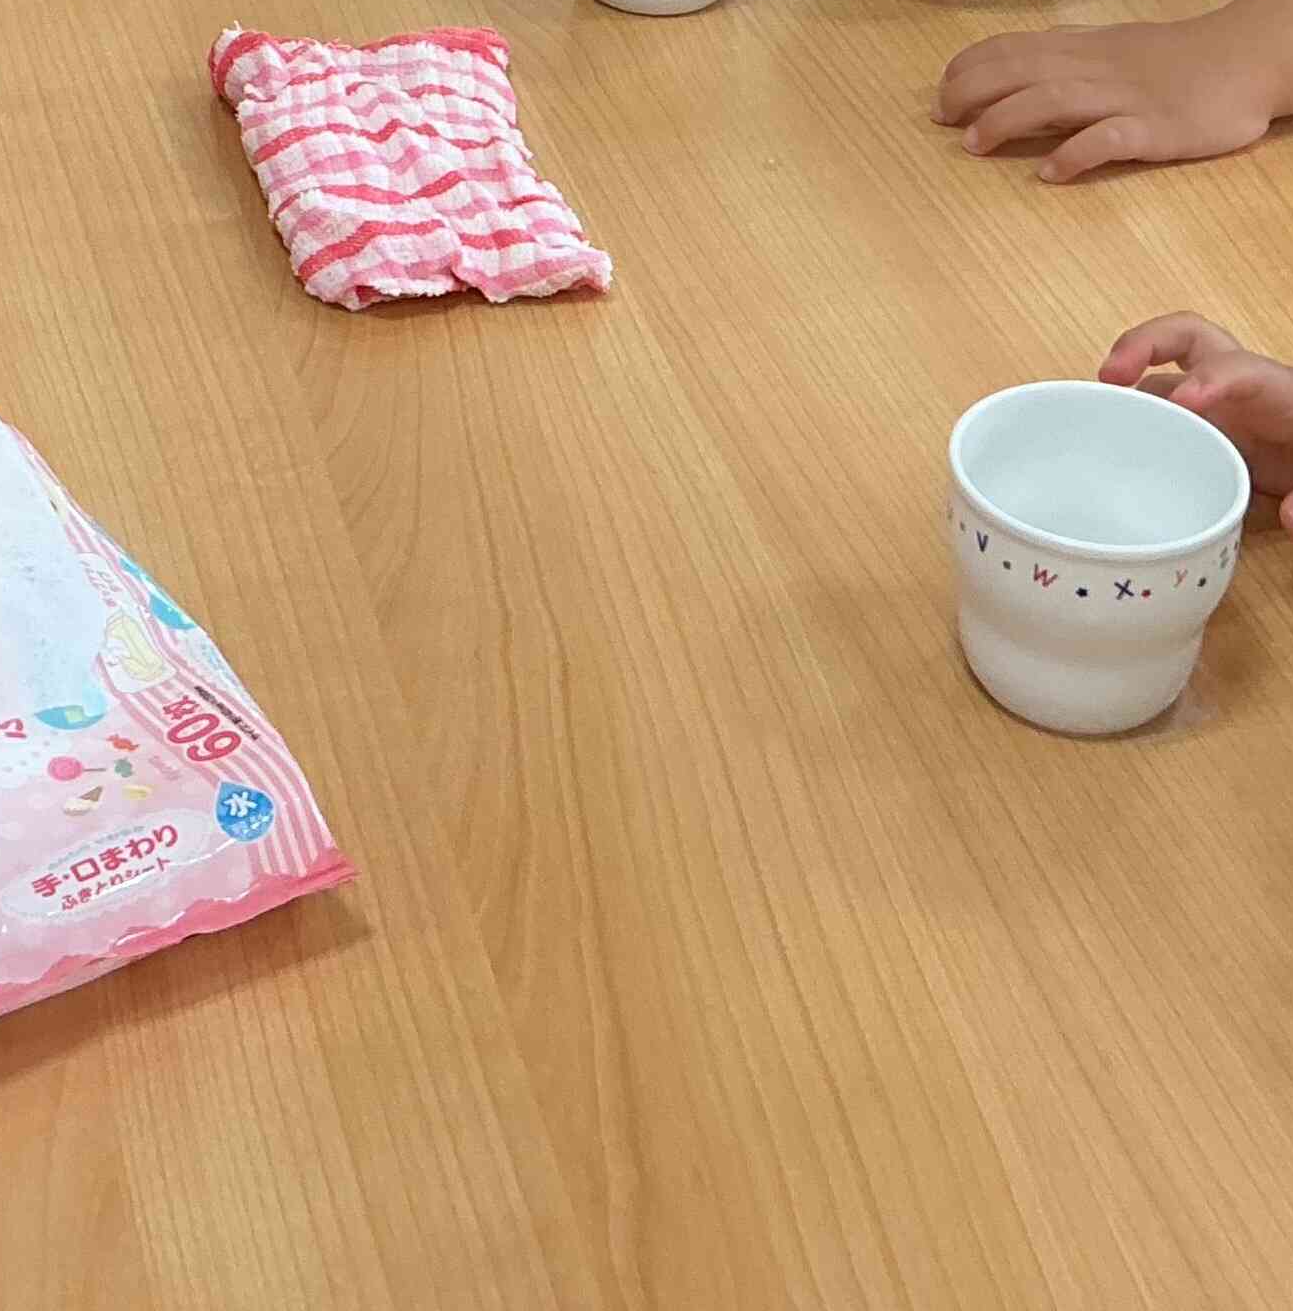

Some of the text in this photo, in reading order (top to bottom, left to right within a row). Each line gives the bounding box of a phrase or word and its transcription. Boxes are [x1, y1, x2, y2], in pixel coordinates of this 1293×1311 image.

[976, 531, 989, 553] V
[1033, 563, 1058, 588] W
[1114, 579, 1135, 600] X
[162, 694, 243, 763] 60枚
